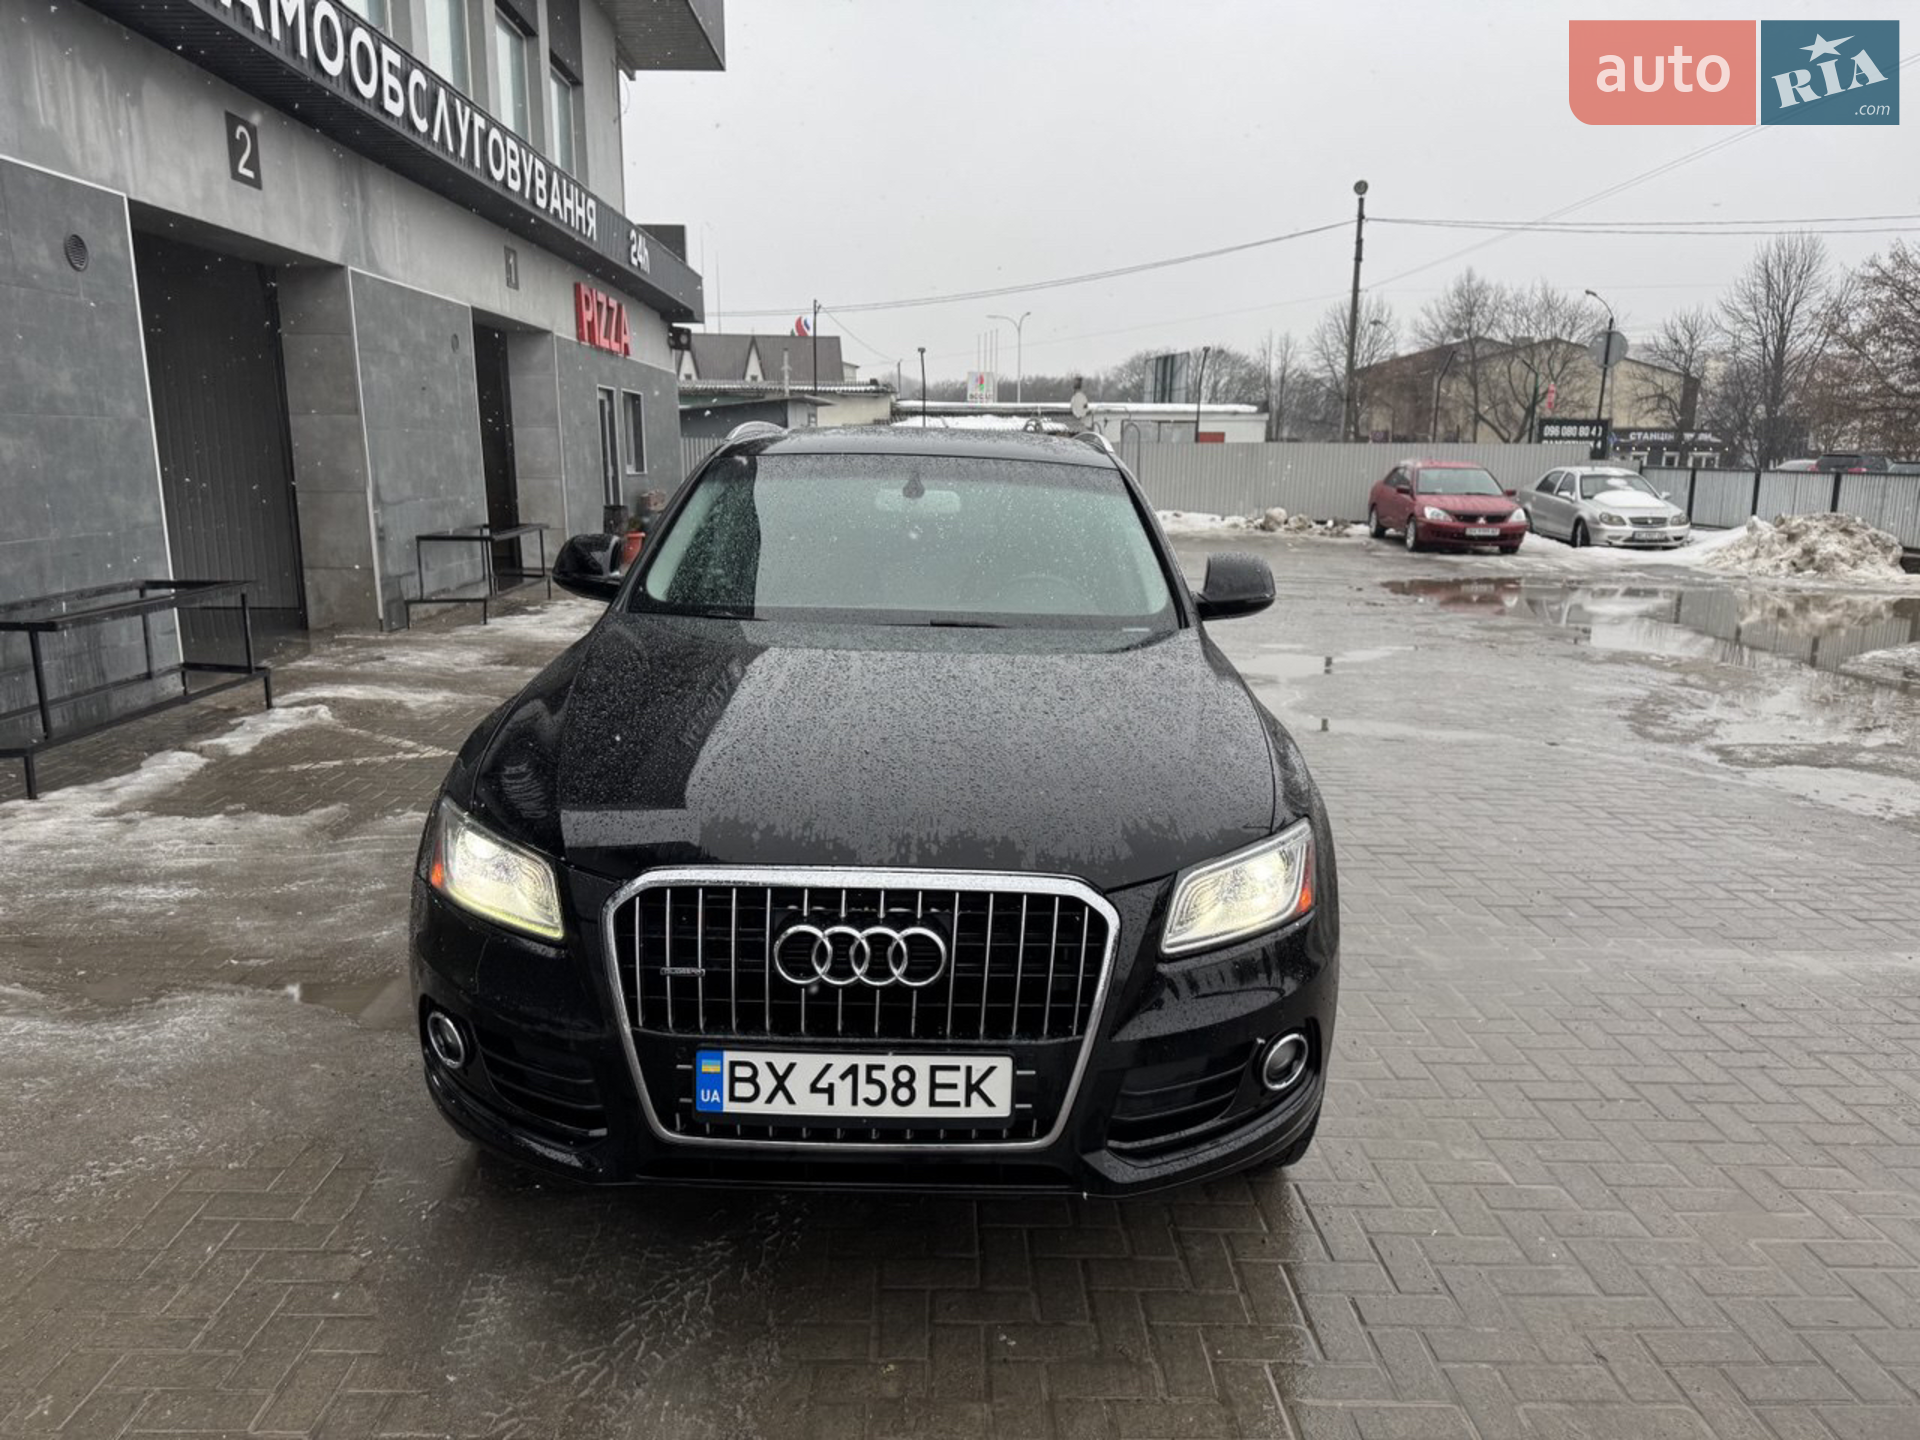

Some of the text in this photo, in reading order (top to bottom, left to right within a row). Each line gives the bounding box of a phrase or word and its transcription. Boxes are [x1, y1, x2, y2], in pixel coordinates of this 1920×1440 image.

[220, 0, 597, 241] МООБСЛУГОВУВАННЯ
[235, 125, 255, 179] 2
[575, 281, 631, 357] PIZZA
[701, 1089, 721, 1103] UA
[729, 1060, 998, 1108] BX 4158 EK
